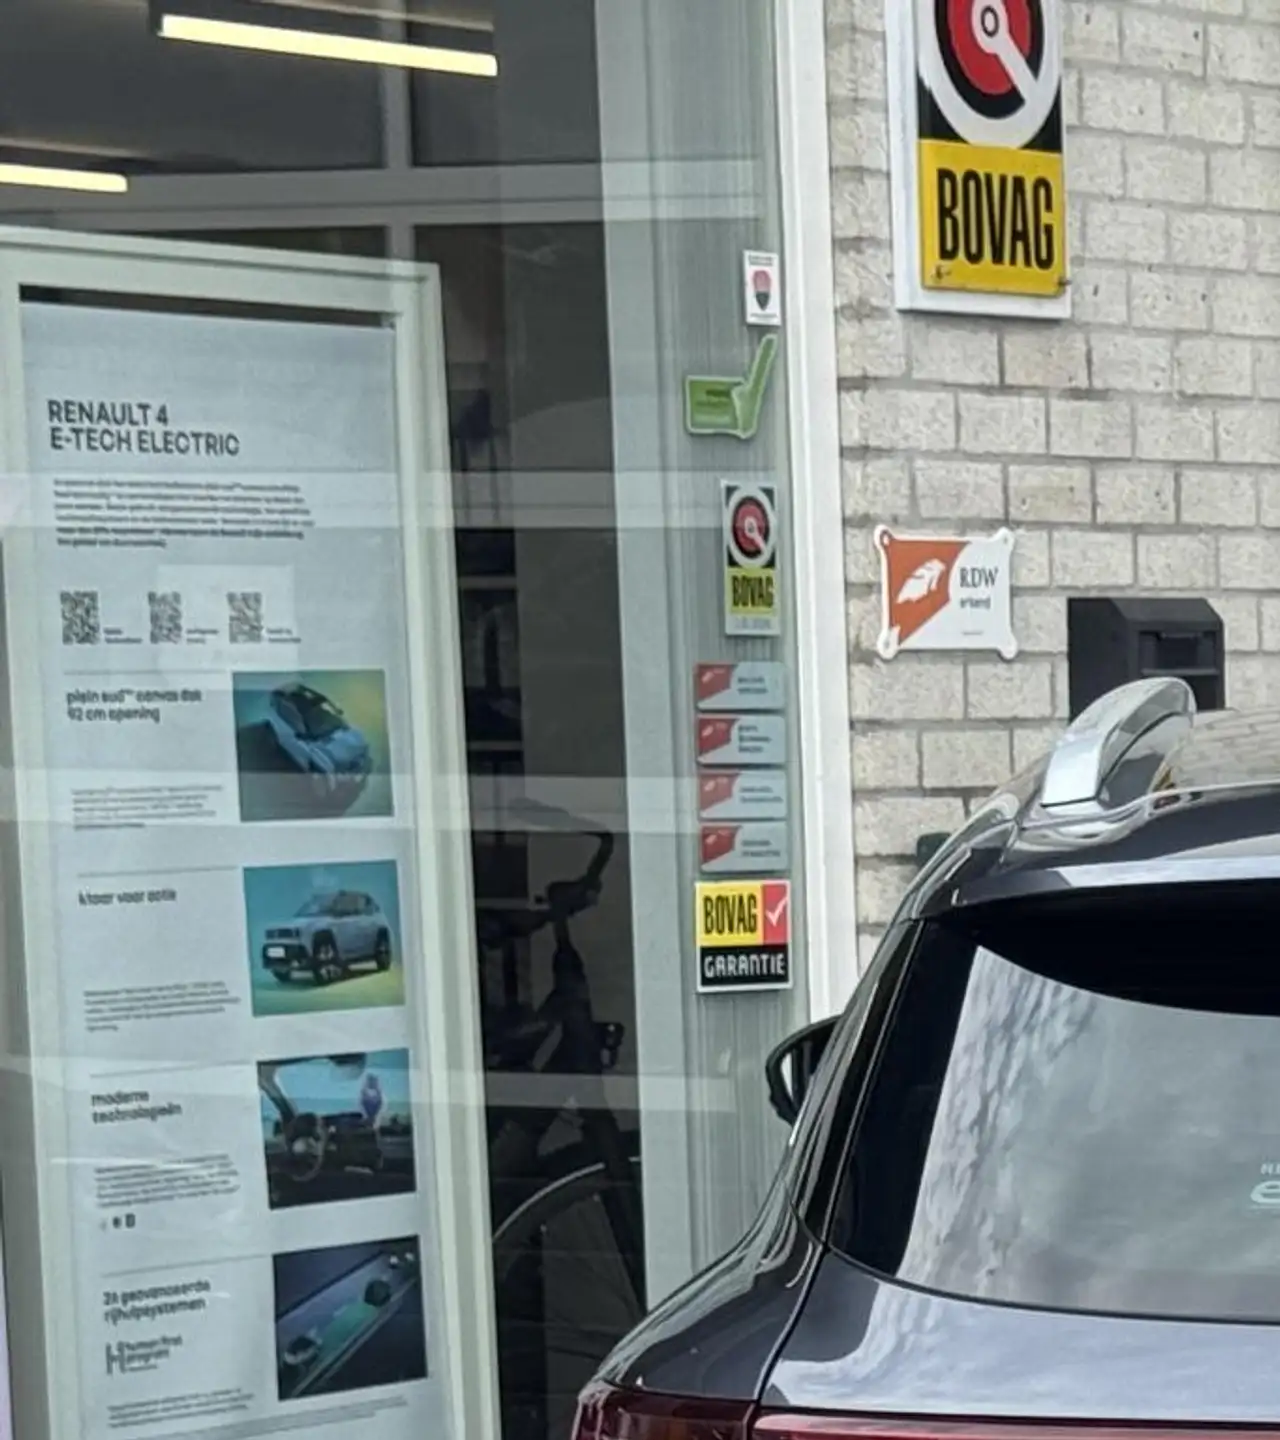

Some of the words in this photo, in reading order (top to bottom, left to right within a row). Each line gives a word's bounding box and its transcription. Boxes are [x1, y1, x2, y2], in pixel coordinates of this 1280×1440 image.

[936, 167, 1055, 271] BOVAG
[47, 399, 152, 427] RENAULT
[156, 404, 169, 426] 4
[50, 426, 132, 452] E-TECH
[138, 429, 240, 457] ELECTRIC
[731, 574, 774, 608] BOVAG
[959, 567, 998, 588] RDW
[85, 708, 106, 721] cm
[108, 706, 160, 724] opening
[703, 893, 757, 935] BOVAG
[703, 952, 785, 978] GARANTIE
